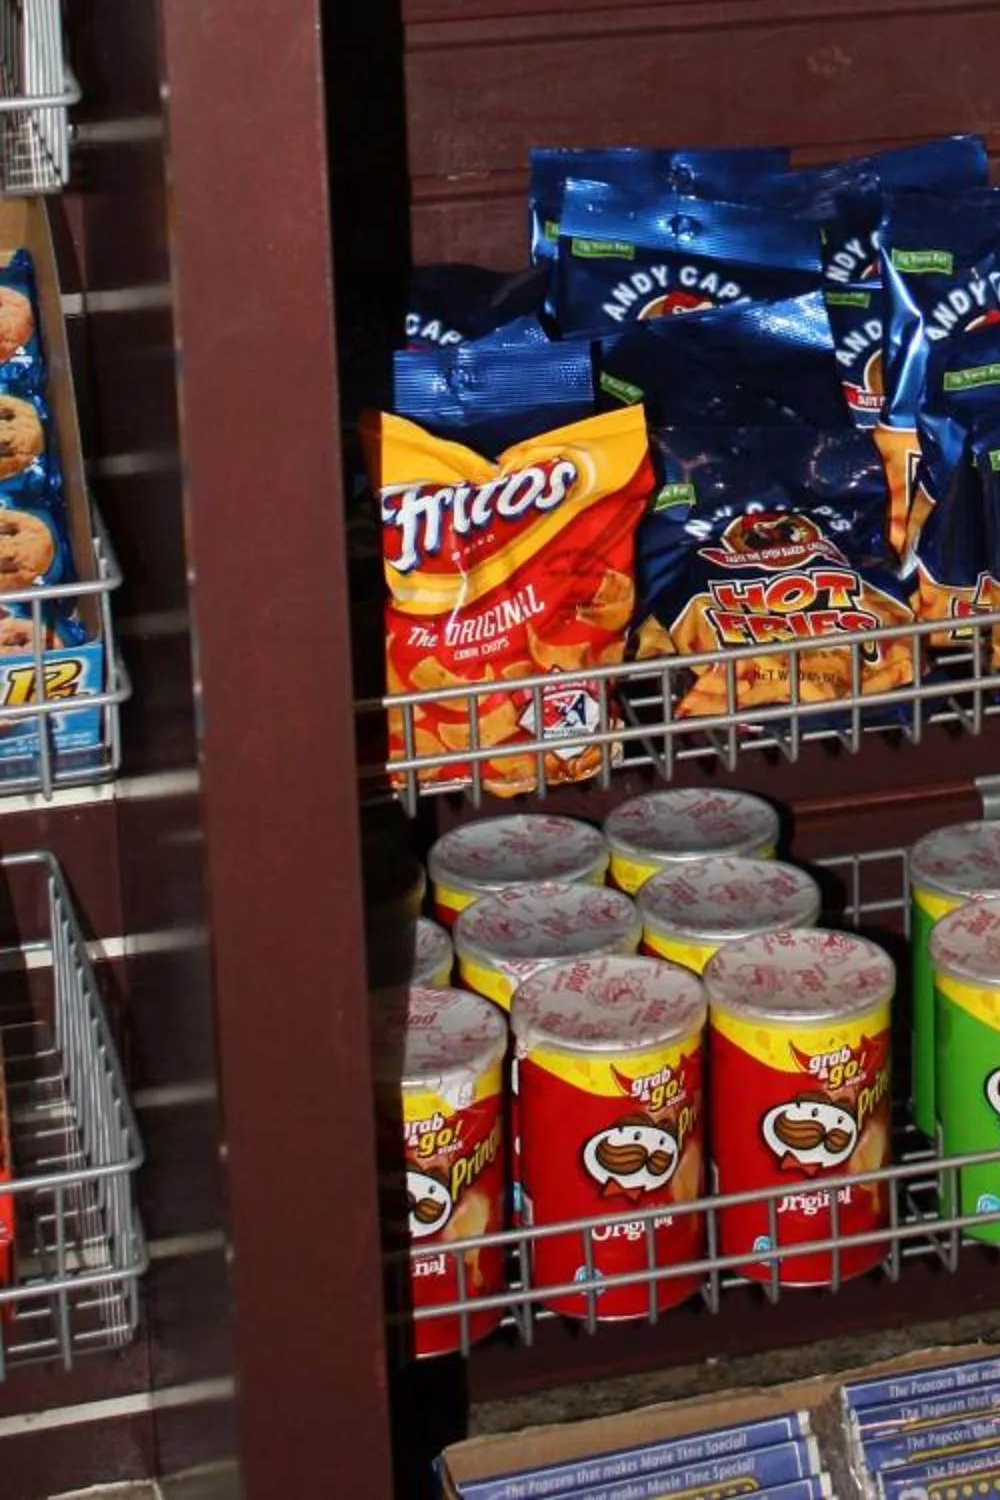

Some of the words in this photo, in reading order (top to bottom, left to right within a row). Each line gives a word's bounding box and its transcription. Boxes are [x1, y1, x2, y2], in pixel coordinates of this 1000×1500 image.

[602, 265, 668, 322] ANDY
[679, 266, 752, 304] CAP
[923, 280, 991, 341] ANDY
[381, 458, 576, 572] Fritos
[712, 571, 858, 615] HOT
[711, 610, 878, 647] FRIES
[8, 660, 82, 706] 12
[577, 1467, 600, 1484] that
[603, 1461, 638, 1480] makes
[641, 1451, 674, 1470] Movie
[678, 1443, 703, 1462] Time
[647, 1473, 682, 1494] Movie
[685, 1465, 711, 1485] Time
